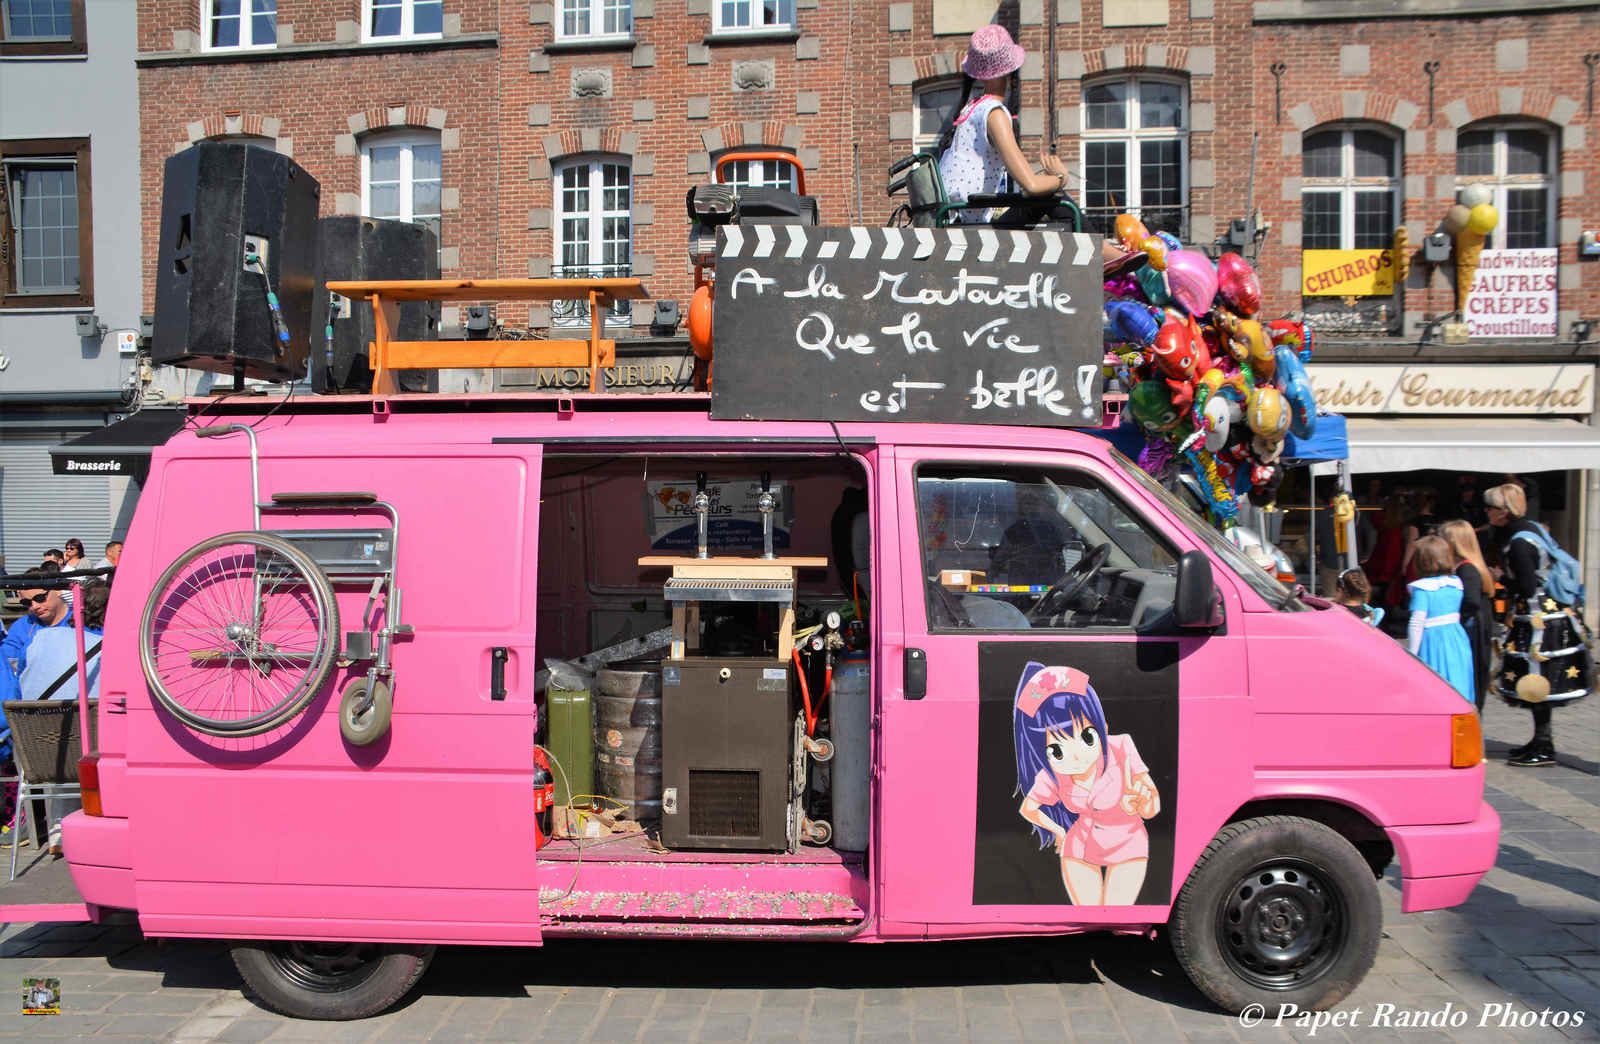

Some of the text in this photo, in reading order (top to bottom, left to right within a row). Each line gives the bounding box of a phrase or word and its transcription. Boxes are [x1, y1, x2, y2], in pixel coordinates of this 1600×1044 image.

[1305, 250, 1392, 293] CHURROS
[1478, 252, 1556, 269] ndwiches
[731, 267, 780, 300] A
[783, 263, 847, 300] la
[796, 312, 1040, 361] Que la vie
[860, 374, 946, 413] est
[1399, 373, 1592, 408] Gourmand
[66, 460, 121, 471] Brasserie
